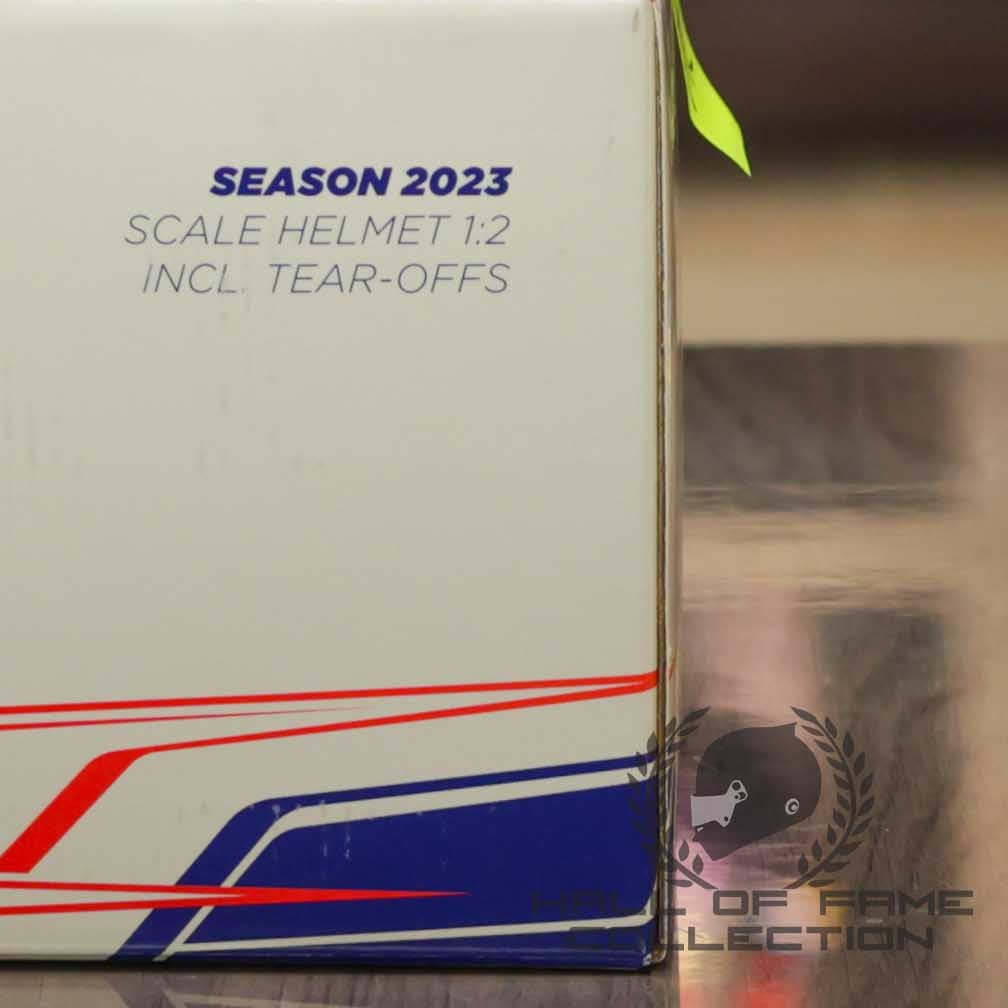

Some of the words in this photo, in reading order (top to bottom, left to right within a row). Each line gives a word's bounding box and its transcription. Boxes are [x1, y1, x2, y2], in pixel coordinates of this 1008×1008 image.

[210, 166, 392, 196] SEASON
[400, 166, 513, 196] 2023
[124, 214, 266, 245] SCALE
[277, 215, 452, 245] HELMET
[464, 215, 511, 245] 1:2
[268, 263, 511, 294] TEAR-OFFS
